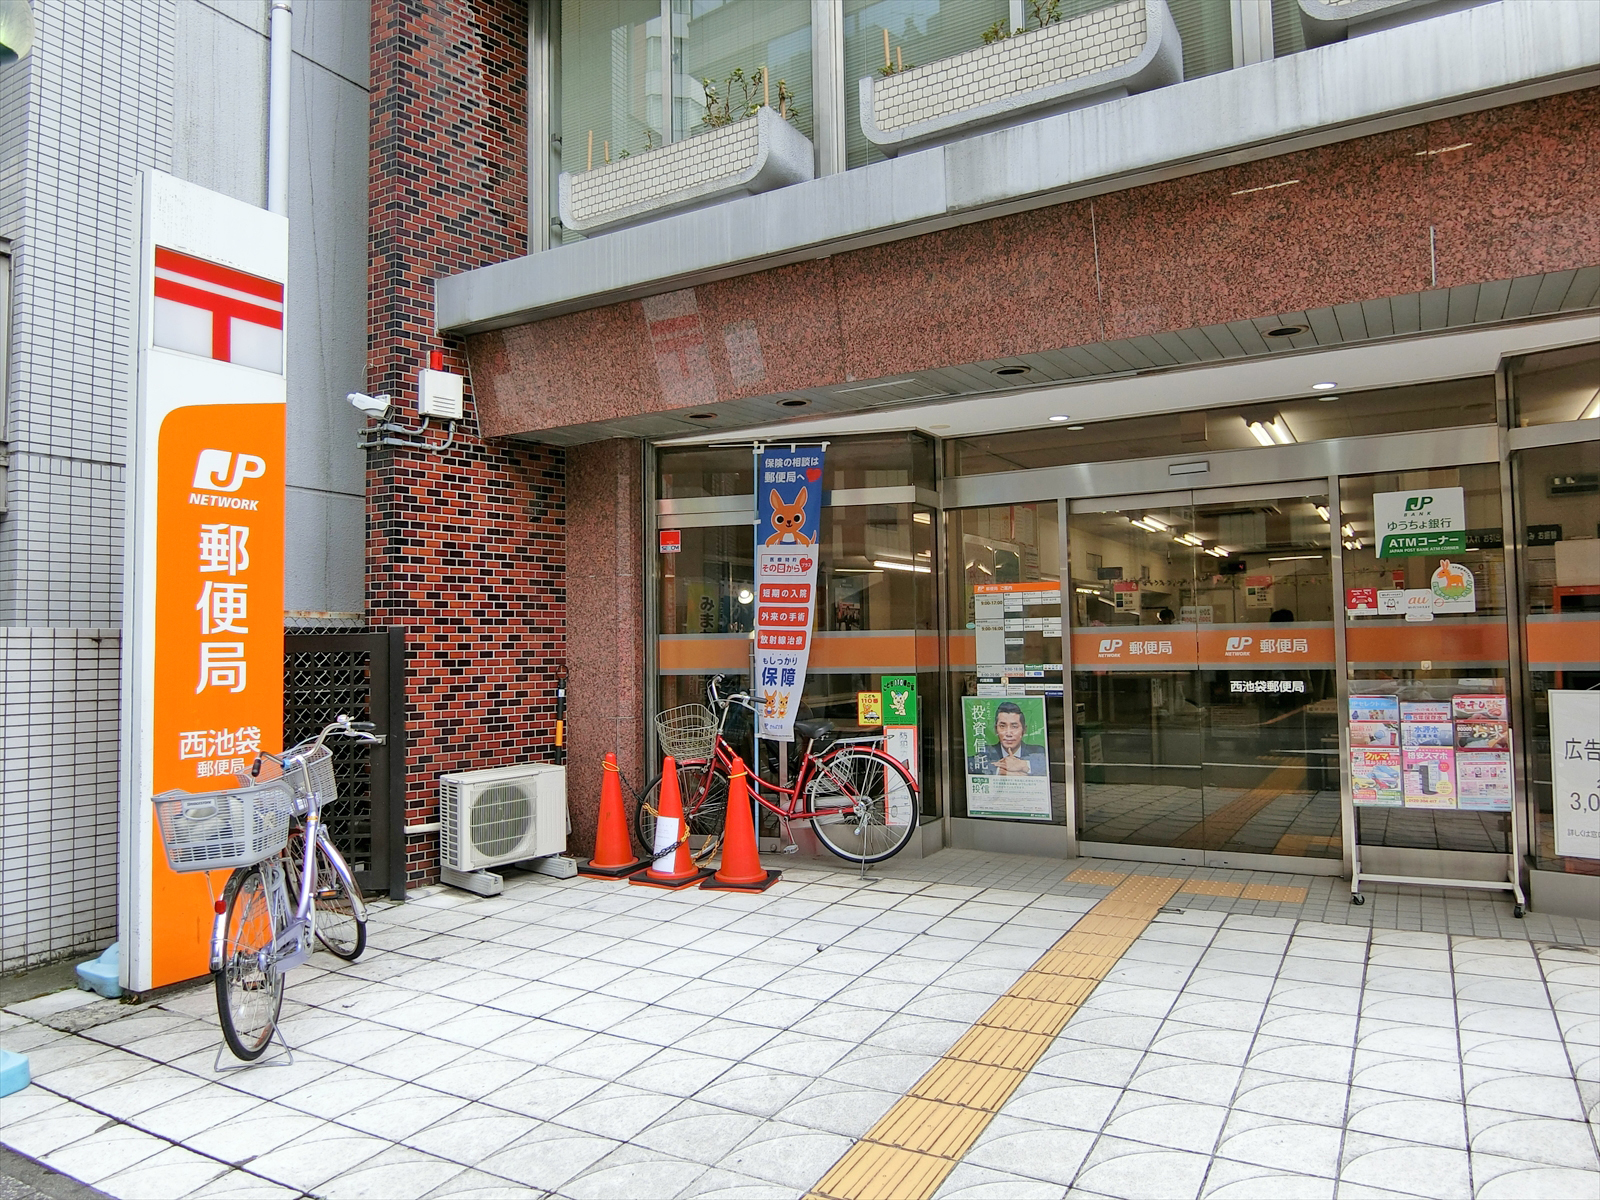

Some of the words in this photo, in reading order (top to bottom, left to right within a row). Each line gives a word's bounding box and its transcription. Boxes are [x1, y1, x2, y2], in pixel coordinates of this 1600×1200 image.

[765, 457, 819, 468] 保険の相談は
[192, 449, 266, 493] JP
[764, 471, 805, 483] 郵便局へ
[189, 493, 260, 511] NETWORK
[1405, 496, 1433, 511] JP
[1387, 518, 1452, 531] ゆうちょ銀行
[1389, 535, 1459, 548] ATMコーナー
[763, 588, 807, 598] 短期の入院
[1408, 595, 1429, 604] au
[195, 523, 250, 695] 郵便局
[761, 611, 805, 622] 外来の手術
[760, 635, 803, 645] 放射線治療
[1098, 639, 1123, 653] JP
[1225, 636, 1253, 652] JP
[1260, 638, 1308, 654] 郵便局
[1129, 640, 1173, 655] 郵便局
[763, 656, 797, 666] もしっかり
[762, 666, 796, 687] 保障
[1230, 680, 1305, 693] 西池袋郵便局
[971, 705, 989, 770] 投資信託
[1472, 724, 1504, 739] お米
[179, 725, 261, 760] 西池袋
[1407, 751, 1448, 760] 格安スマホ
[1564, 738, 1600, 762] 広告
[197, 758, 245, 778] 郵便局
[972, 784, 990, 794] 投信
